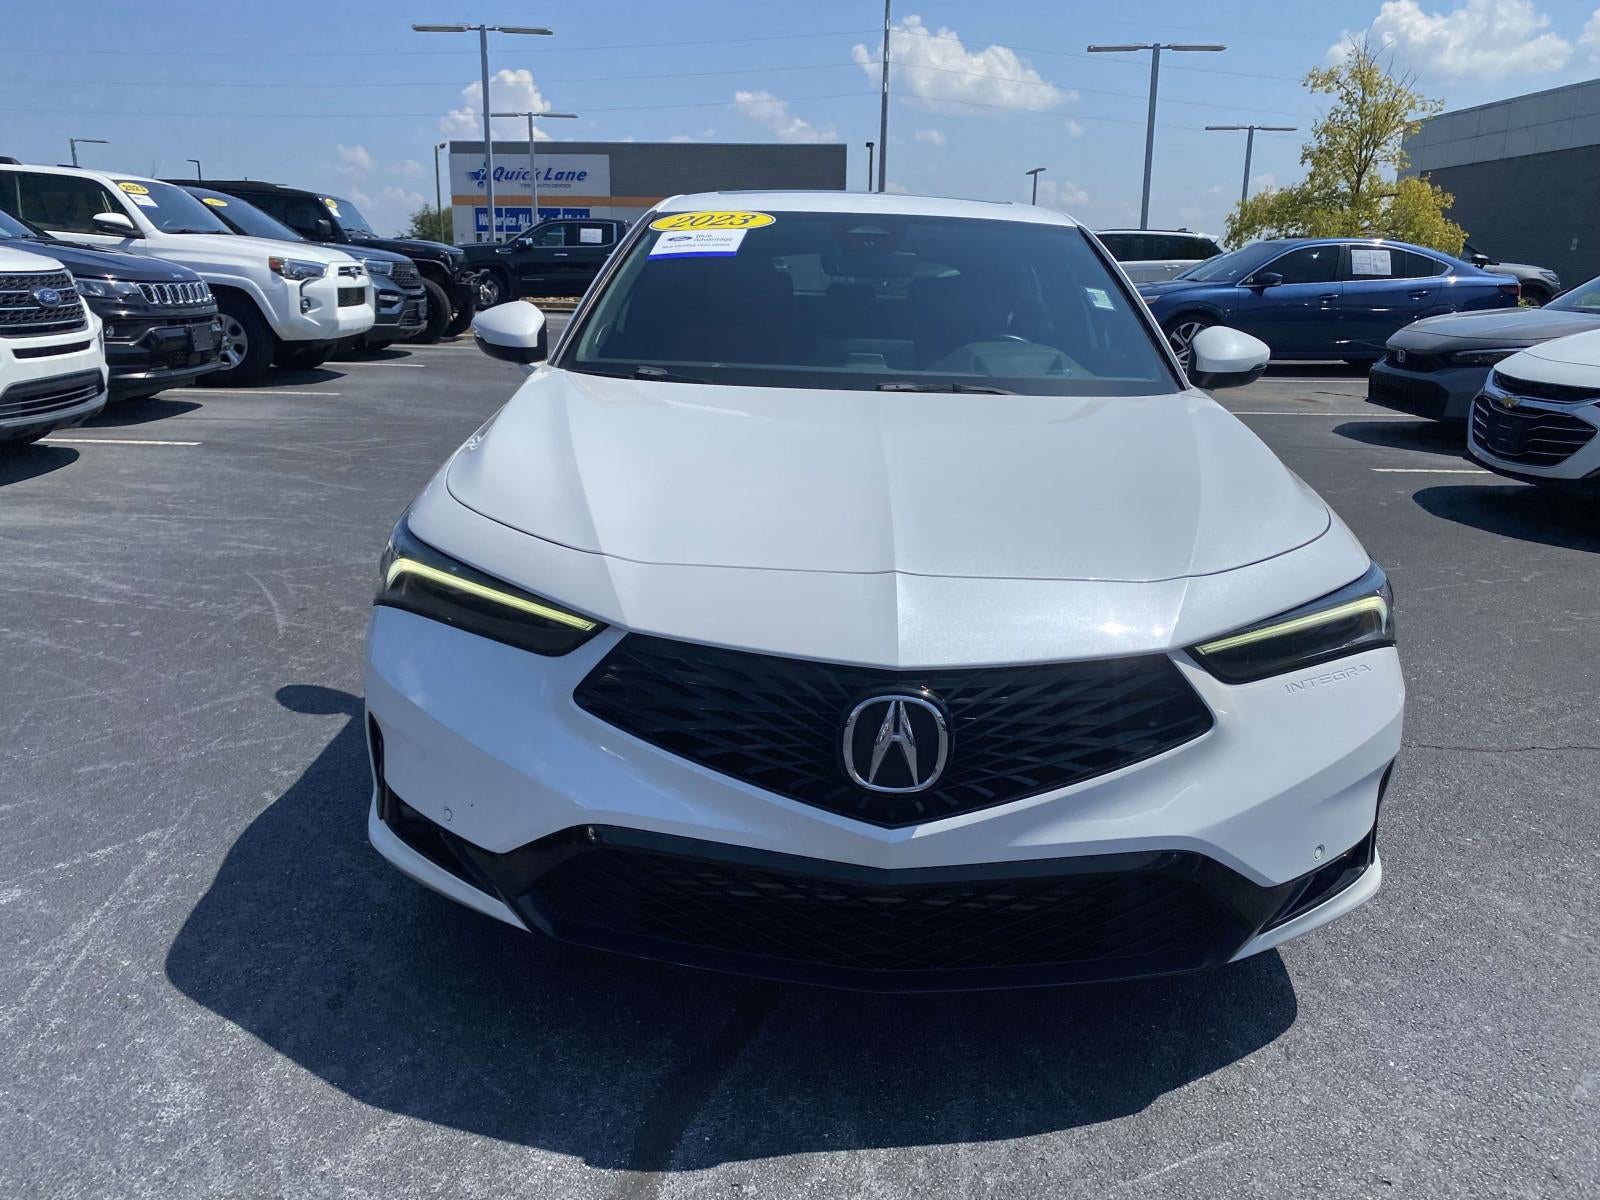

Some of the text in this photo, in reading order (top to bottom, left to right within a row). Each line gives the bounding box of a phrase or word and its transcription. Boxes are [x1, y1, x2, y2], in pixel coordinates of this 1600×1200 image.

[543, 168, 588, 181] Lane
[667, 214, 758, 228] 2023
[1284, 664, 1373, 694] INTEGRA
